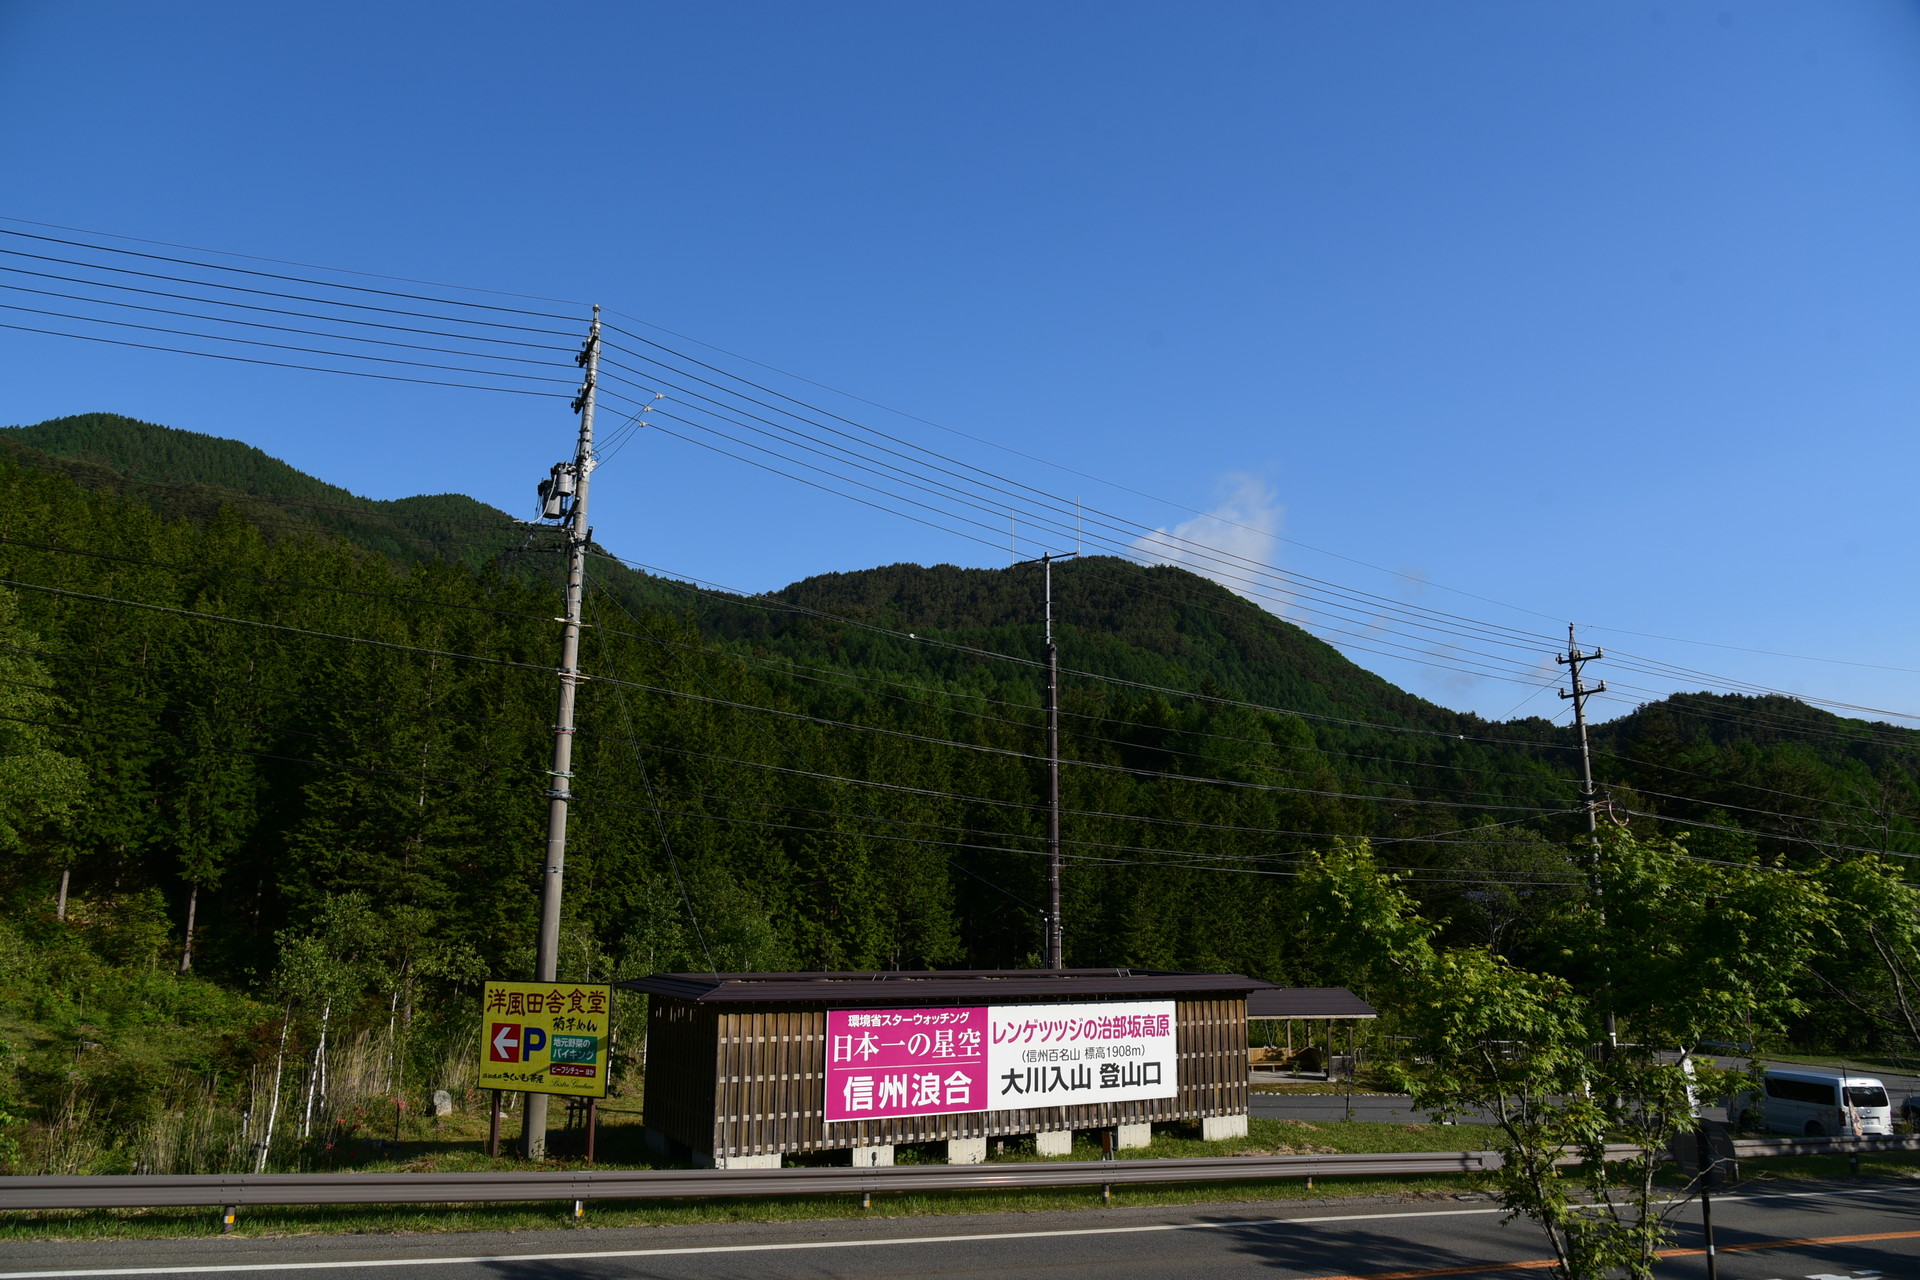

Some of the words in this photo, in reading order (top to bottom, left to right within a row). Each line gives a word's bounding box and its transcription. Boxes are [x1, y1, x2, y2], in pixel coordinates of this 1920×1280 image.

[487, 988, 606, 1016] 洋風田舎食堂
[848, 1011, 970, 1027] 環境省スターウォッチング
[993, 1014, 1170, 1044] レンゲツツジの治部坂高原
[522, 1027, 547, 1062] P
[552, 1049, 595, 1061] バイキング
[553, 1037, 590, 1048] 地元野菜の
[833, 1028, 981, 1062] 日本一の星空
[843, 1070, 972, 1112] 信州浪合
[1001, 1063, 1091, 1095] 大川入山
[1099, 1061, 1162, 1090] 登山口
